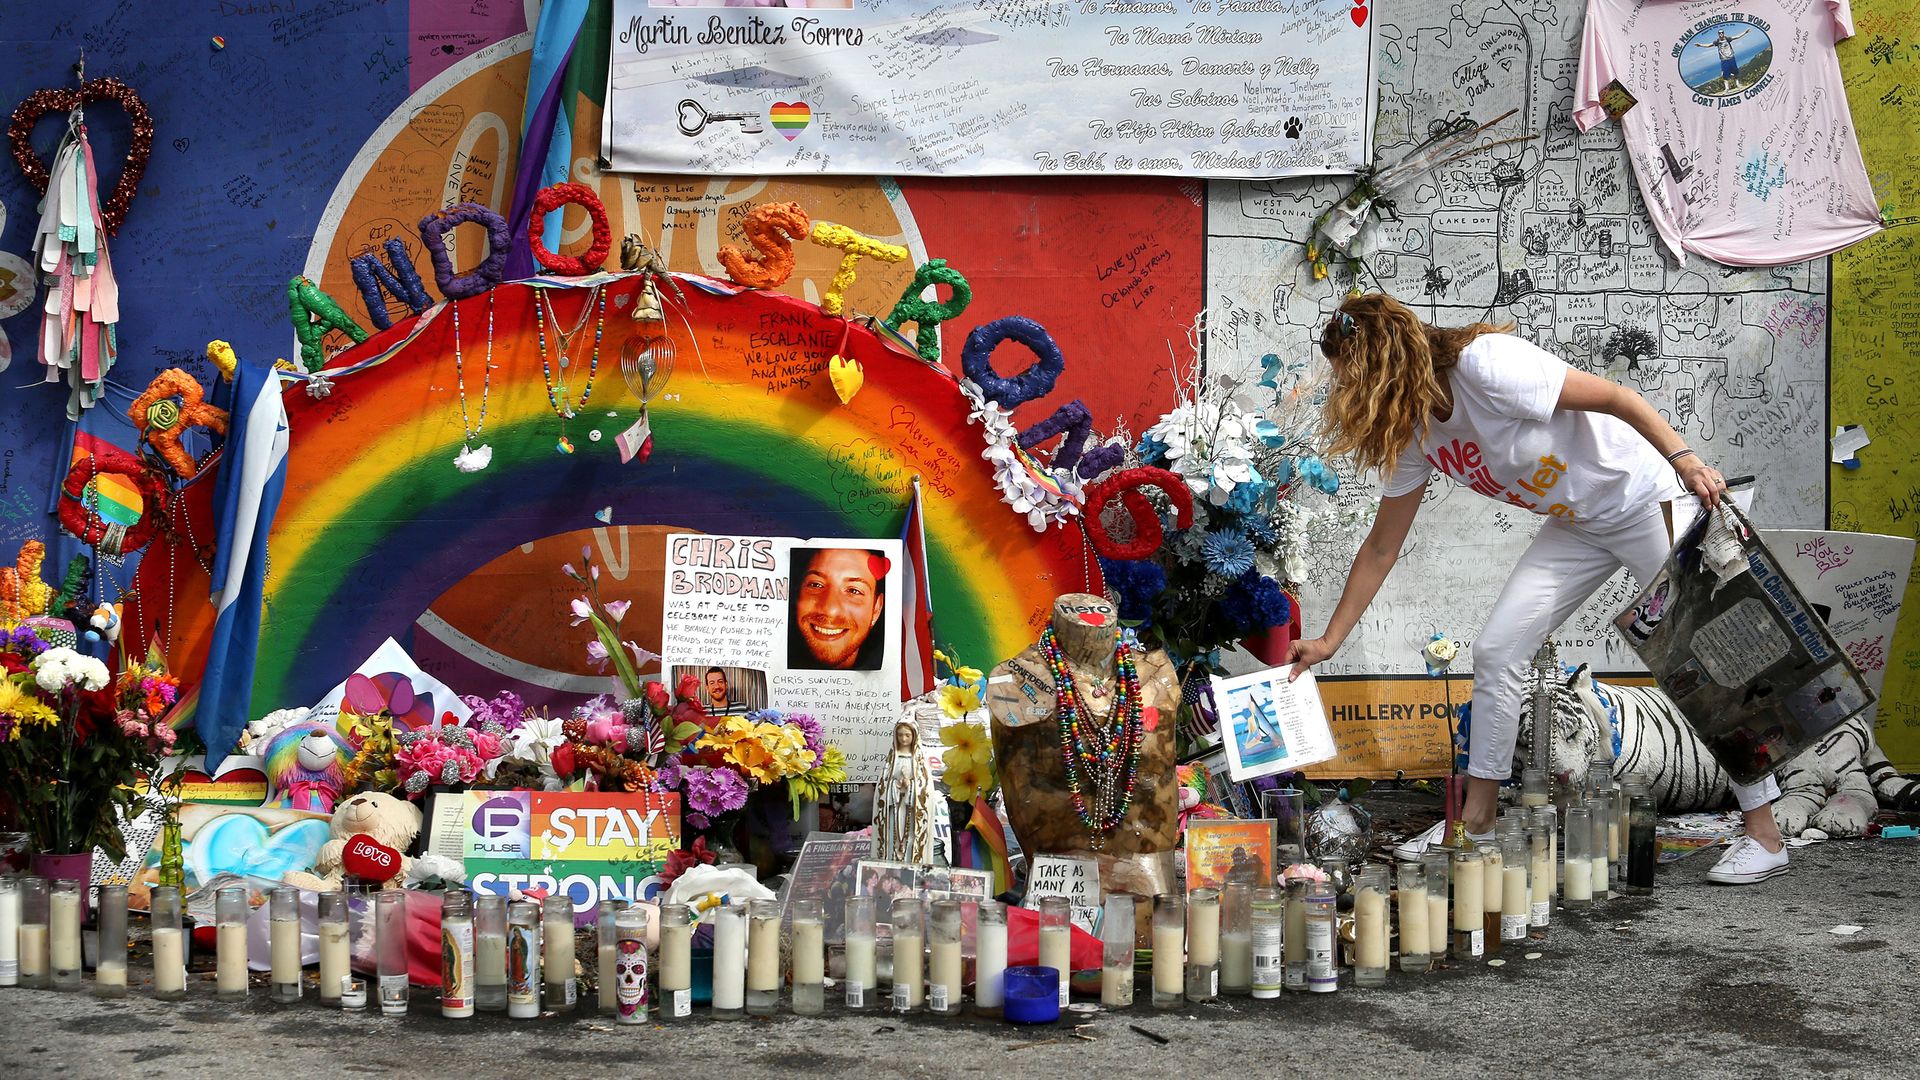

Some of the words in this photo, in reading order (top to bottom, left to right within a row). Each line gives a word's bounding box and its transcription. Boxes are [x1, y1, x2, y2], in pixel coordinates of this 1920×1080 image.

[1075, 0, 1097, 14] Te
[1101, 0, 1177, 15] Amamos,
[1186, 0, 1211, 13] Tu
[620, 15, 692, 54] Martin
[697, 15, 787, 45] Benitez
[791, 16, 864, 47] Torres
[1105, 25, 1130, 46] Tu
[1133, 22, 1194, 45] Mamá
[1196, 25, 1262, 45] Miriam
[1479, 28, 1525, 52] KINGSWOOD
[1671, 42, 1683, 58] ONE
[1679, 29, 1695, 42] MAN
[1694, 13, 1729, 32] CHANGING
[1731, 12, 1745, 21] THE
[1748, 14, 1771, 32] WORLD
[1046, 57, 1079, 77] Tus
[1082, 57, 1173, 78] Hermanas,
[1181, 56, 1255, 76] Damaris
[1259, 63, 1271, 80] y
[1274, 56, 1319, 80] Nelly
[1452, 55, 1489, 89] College
[1465, 71, 1495, 107] Park
[1130, 88, 1162, 107] Tus
[1167, 88, 1238, 108] Sobrinos
[1089, 120, 1113, 140] Tu
[1116, 120, 1156, 144] Hijo
[1160, 120, 1215, 139] Hilton
[1220, 119, 1281, 144] Gabriel
[1034, 151, 1058, 171] Tu
[1115, 154, 1133, 171] tu
[1137, 158, 1183, 172] amor,
[1191, 150, 1262, 171] Michael
[1265, 149, 1325, 169] Morales
[448, 151, 468, 190] LOVE
[633, 182, 656, 193] LOVE
[1253, 199, 1282, 208] WEST
[1591, 181, 1621, 212] North
[1262, 208, 1314, 219] COLONIAL
[369, 223, 393, 241] RIP
[1096, 257, 1124, 281] LOVE
[1454, 261, 1496, 300] Parramore
[759, 311, 815, 330] FRANK
[1558, 315, 1605, 323] GREENWOOD
[750, 331, 838, 350] ESCALANTE
[744, 352, 761, 366] We
[57, 183, 612, 565] ORANDO
[717, 200, 1193, 562] STRONG
[781, 365, 809, 378] MISS
[1427, 438, 1482, 476] We
[1517, 453, 1569, 498] let
[1796, 537, 1826, 558] LOVE
[1808, 546, 1834, 562] YOU
[1816, 553, 1842, 571] BIG
[671, 571, 789, 601] BRODMAN
[669, 600, 691, 609] WAS
[697, 601, 710, 609] AT
[717, 601, 748, 612] PULSE
[755, 603, 770, 611] TO
[1059, 604, 1112, 614] hero
[667, 612, 717, 622] CELEBRATE
[684, 624, 716, 635] BRAVELY
[721, 626, 752, 635] PUSHED
[704, 637, 723, 645] OVER
[728, 638, 740, 646] THE
[746, 639, 768, 648] BACK
[666, 646, 692, 654] FENCE
[746, 649, 773, 657] MAKE
[693, 657, 711, 665] THEY
[716, 659, 740, 667] WERE
[1320, 662, 1351, 675] LOVE
[1358, 663, 1367, 674] IS
[1008, 660, 1056, 697] CONFIDENCE
[774, 688, 822, 698] HOWEVER,
[774, 700, 780, 708] A
[787, 700, 808, 708] RARE
[1332, 704, 1415, 721] HILLERY
[832, 715, 866, 724] MONTHS
[845, 753, 857, 761] NO
[843, 784, 860, 793] END
[550, 807, 661, 847] STAY
[474, 843, 521, 852] PULSE
[805, 843, 811, 852] A
[1038, 865, 1067, 877] TAKE
[1073, 865, 1084, 877] AS
[472, 872, 666, 914] STRONG
[1034, 880, 1065, 892] MANY
[1072, 881, 1085, 893] AS
